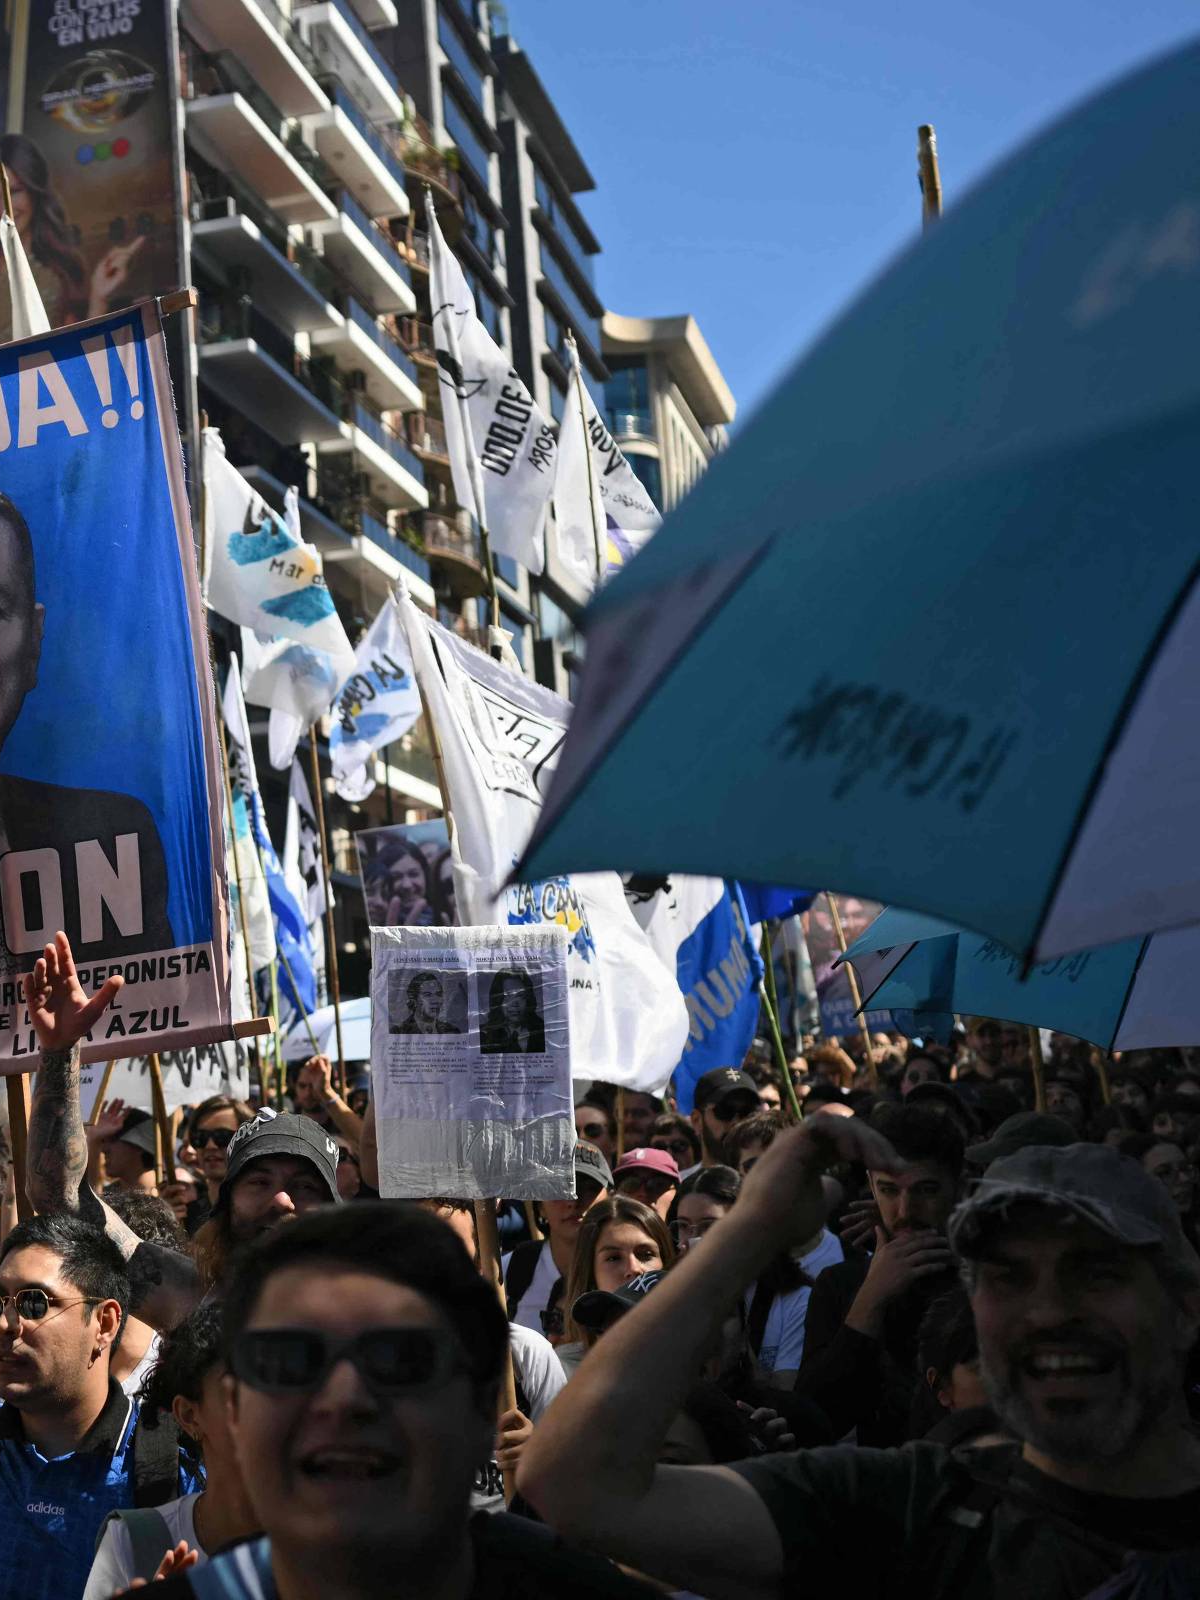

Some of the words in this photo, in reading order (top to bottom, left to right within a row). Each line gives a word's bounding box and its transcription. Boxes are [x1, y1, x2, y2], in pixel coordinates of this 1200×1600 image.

[48, 9, 85, 33] CON
[57, 28, 84, 47] EN
[86, 16, 134, 40] VIVO
[268, 557, 304, 580] Mar
[105, 1006, 190, 1039] AZUL
[26, 1501, 66, 1516] adidas
